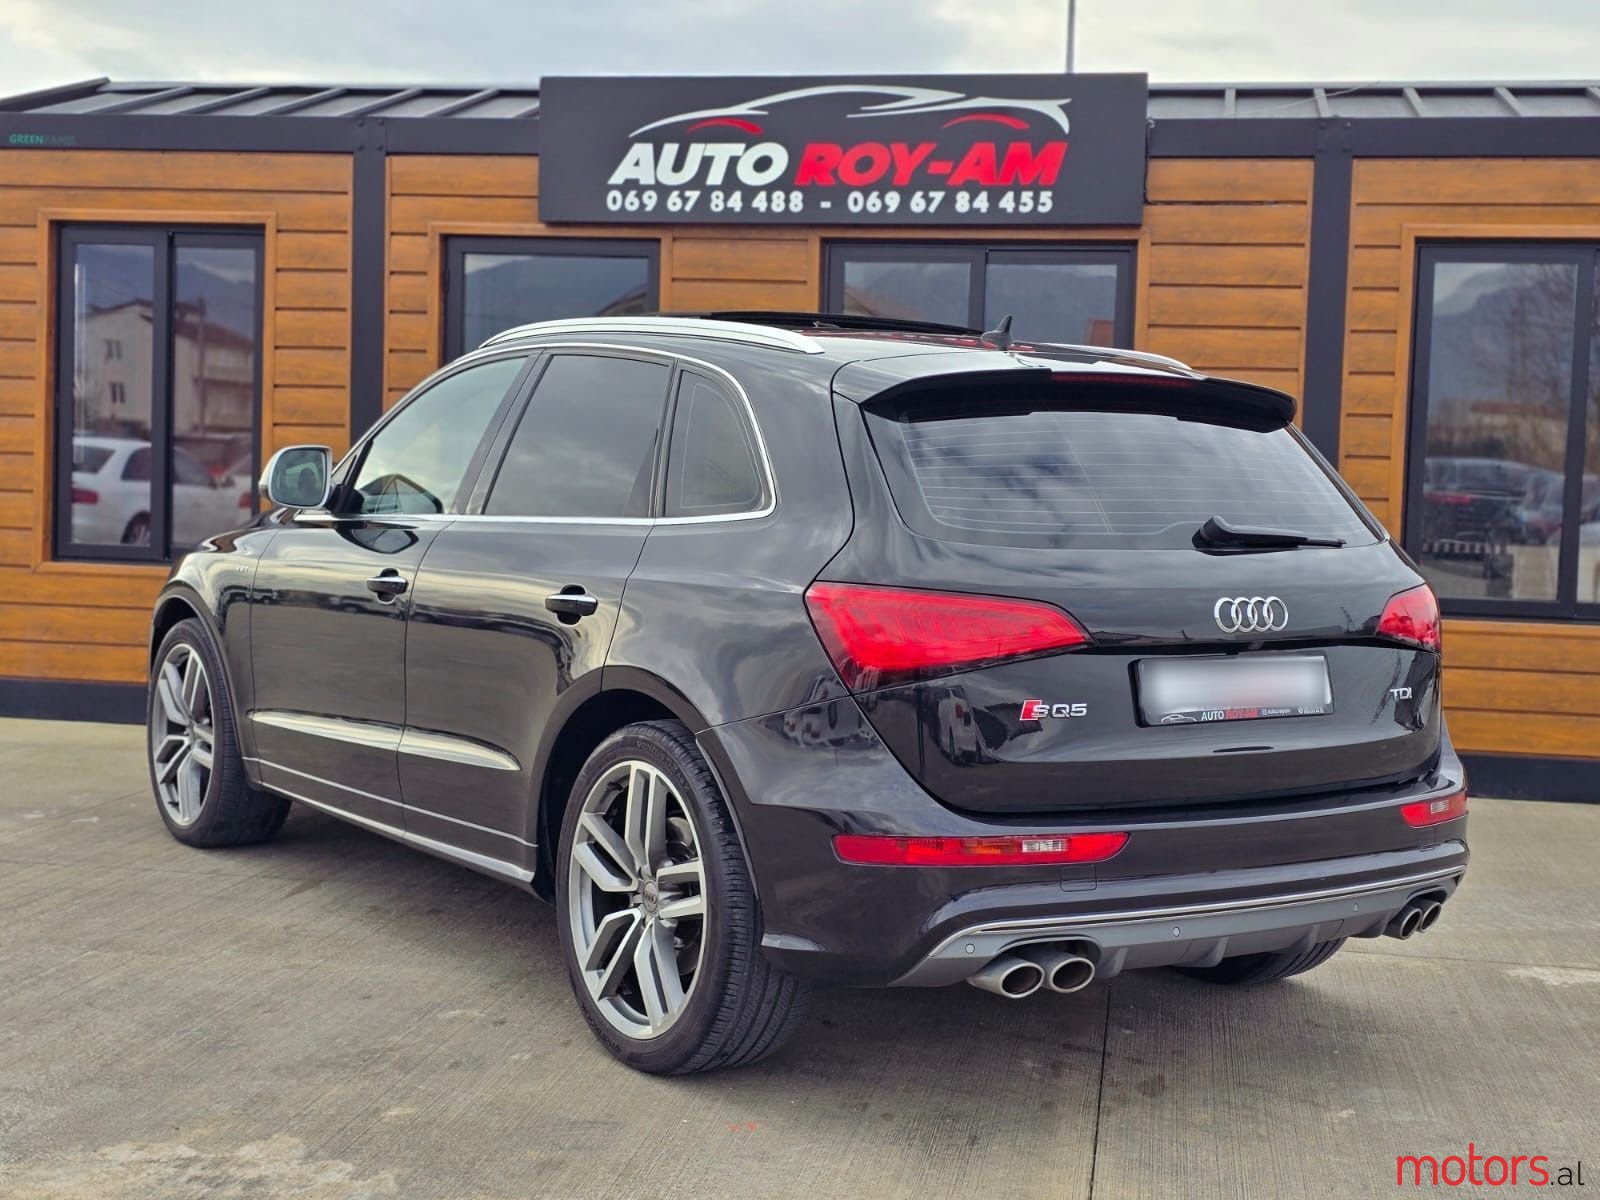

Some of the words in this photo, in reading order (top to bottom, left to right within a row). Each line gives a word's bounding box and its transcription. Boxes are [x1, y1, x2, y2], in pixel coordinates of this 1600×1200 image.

[607, 142, 789, 186] AUTO
[794, 142, 1068, 186] ROY-AM
[606, 190, 658, 212] 069
[666, 190, 701, 212] 67
[710, 190, 743, 213] 84
[752, 190, 804, 213] 488
[847, 191, 901, 213] 069
[910, 191, 946, 213] 67
[955, 191, 990, 213] 84
[998, 191, 1053, 213] 455
[1390, 687, 1412, 700] TDI
[1201, 710, 1225, 721] AUTO
